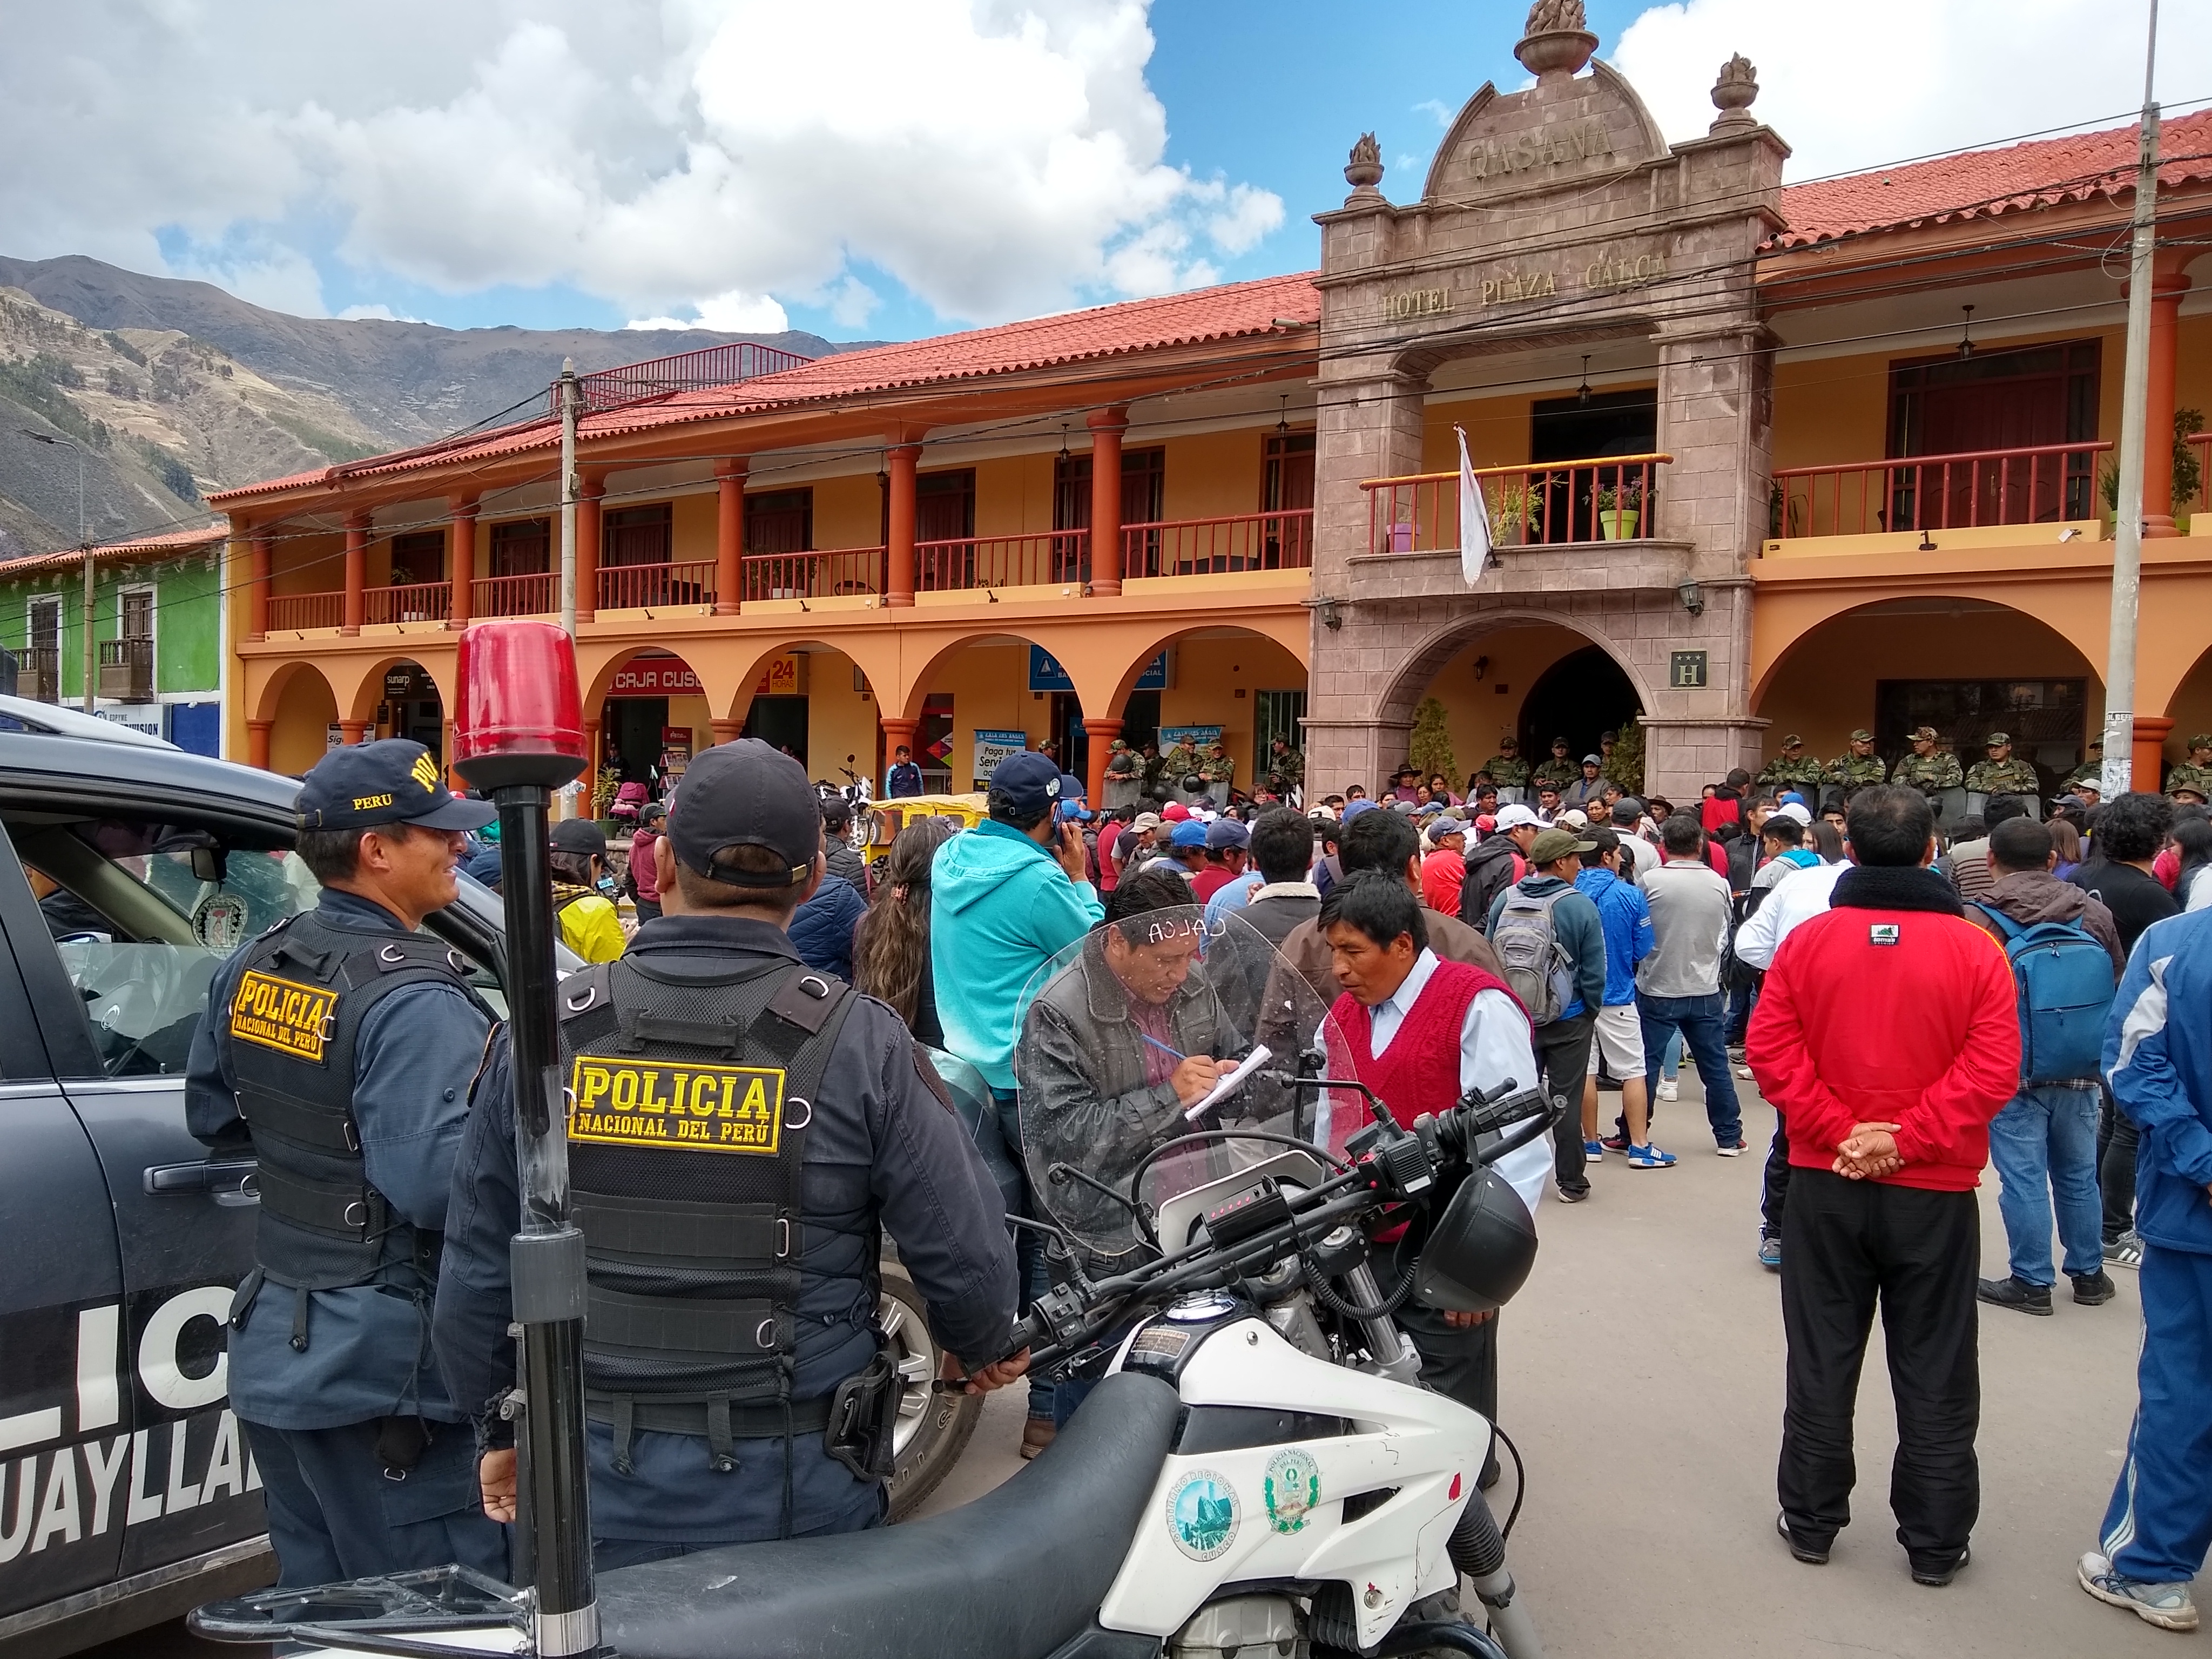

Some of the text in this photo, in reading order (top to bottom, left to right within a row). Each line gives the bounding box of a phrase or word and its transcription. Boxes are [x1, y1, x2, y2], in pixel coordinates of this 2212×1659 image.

[1466, 113, 1615, 178] QASANA
[1382, 252, 1669, 321] HOTEL PLAZA CALCA
[615, 672, 657, 689] CAJA
[772, 660, 794, 679] 24
[1677, 664, 1700, 685] H
[387, 675, 410, 687] sunarp
[772, 679, 794, 688] HORAS
[109, 714, 128, 722] EDPYME
[984, 747, 1003, 757] Paga
[353, 793, 393, 811] PERU
[238, 979, 324, 1032] POLICIA
[235, 1014, 276, 1039] NACIONAL
[277, 1026, 291, 1044] DEL
[579, 1067, 771, 1121] POLICIA
[578, 1113, 667, 1137] NACIONAL
[677, 1120, 711, 1140] DEL
[1269, 1449, 1313, 1473] POLICIA NACIONAL
[1279, 1459, 1304, 1469] DEL PERU
[1168, 1471, 1238, 1542] GOBIERNO REGIONAL
[1202, 1532, 1236, 1561] CUSCO
